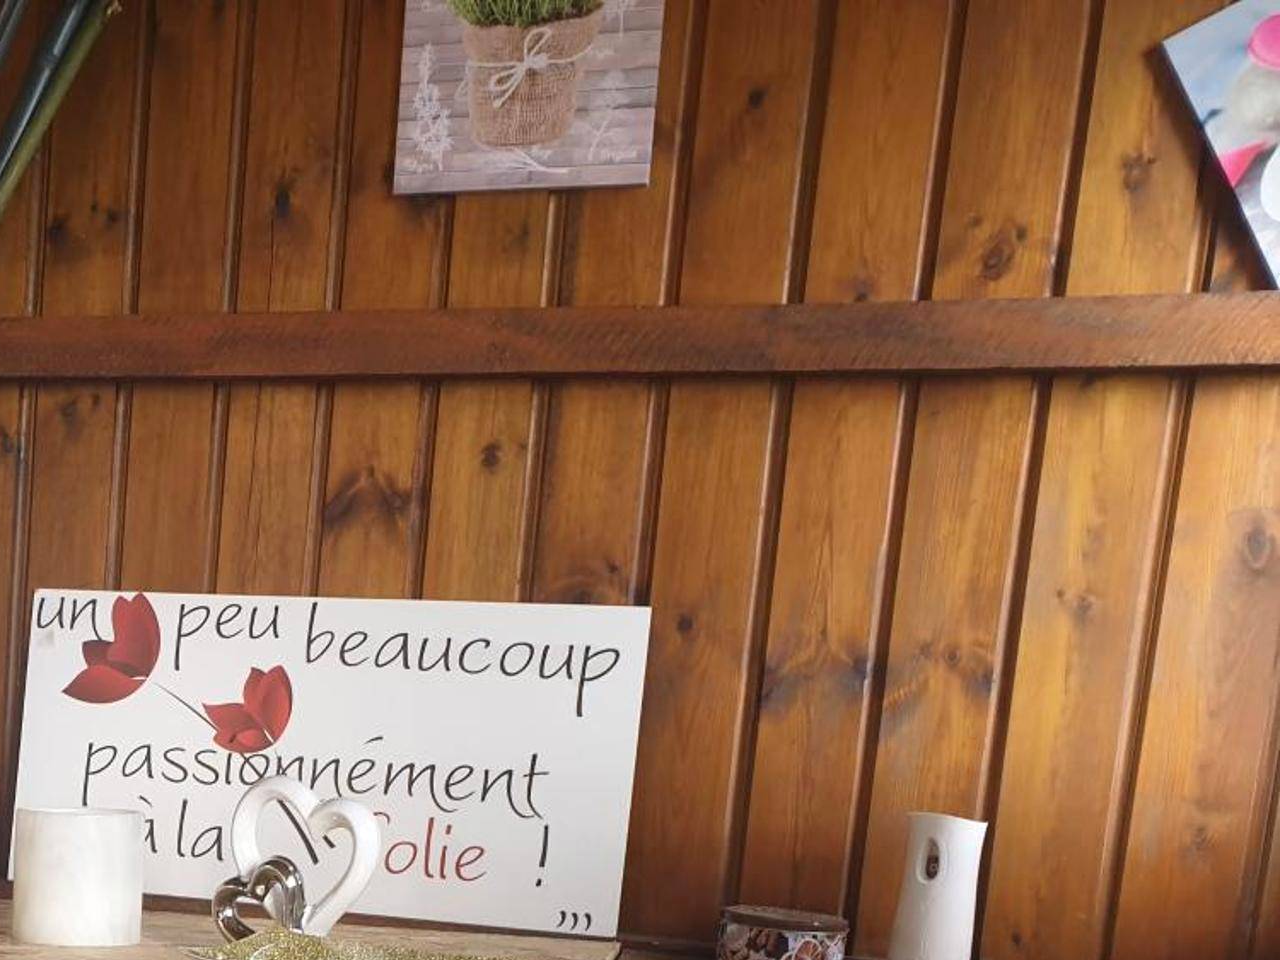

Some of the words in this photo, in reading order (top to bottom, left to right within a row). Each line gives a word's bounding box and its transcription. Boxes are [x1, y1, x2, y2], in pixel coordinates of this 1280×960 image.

[36, 596, 104, 641] un
[173, 603, 280, 671] peu
[306, 601, 621, 718] beaucoup
[81, 736, 550, 820] passionnément
[177, 798, 225, 861] la
[372, 812, 487, 882] olie
